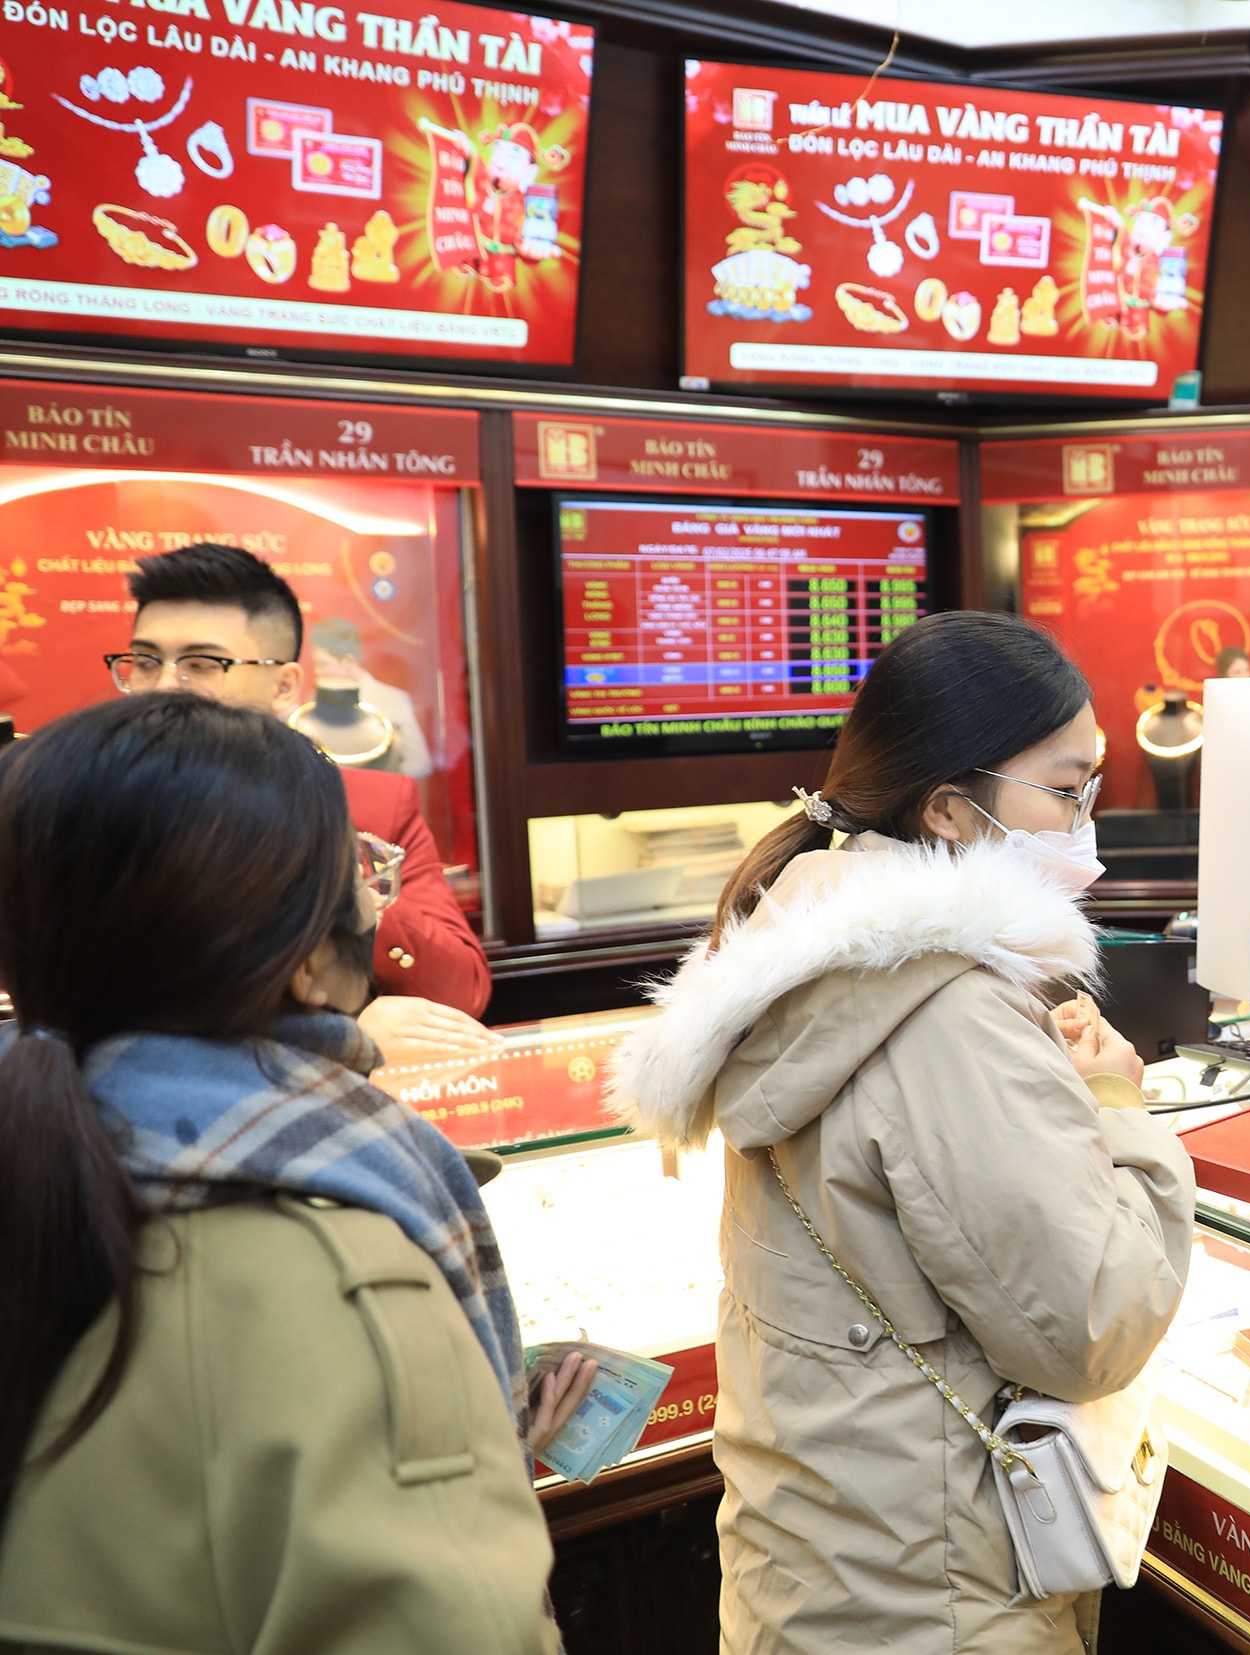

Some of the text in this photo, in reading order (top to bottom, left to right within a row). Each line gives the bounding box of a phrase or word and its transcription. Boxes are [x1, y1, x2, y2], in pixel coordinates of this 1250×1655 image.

[356, 14, 470, 64] THẦN
[478, 32, 542, 75] TÀI
[147, 24, 202, 53] LÂU
[210, 34, 257, 62] DÀI
[279, 47, 317, 72] AN
[323, 54, 410, 87] KHANG
[417, 69, 465, 95] PHÚ
[470, 77, 540, 106] THỊNH
[855, 99, 931, 134] MUA
[936, 103, 1029, 143] VÀNG
[1035, 112, 1124, 154] THẦN
[1129, 121, 1180, 157] TÀI
[883, 139, 923, 161] LÂU
[927, 143, 962, 164] DÀI
[976, 149, 1006, 168] AN
[1008, 152, 1075, 174] KHANG
[1078, 157, 1118, 178] PHÚ
[1121, 161, 1176, 183] THỊNH
[27, 403, 132, 429] BẢO TÍN
[4, 428, 155, 457] MINH CHÂU
[337, 420, 373, 444] 29
[250, 440, 456, 475] TRẦN NHÂN TÔNG
[687, 437, 716, 459] TÍN
[857, 448, 884, 469] 29
[630, 459, 732, 482] MINH CHÂU
[845, 469, 894, 492] NHÂN
[897, 472, 943, 495] TÔNG
[86, 527, 154, 550] VÀNG
[158, 531, 236, 551] TRNG
[446, 1074, 498, 1098] MÔN
[1163, 1519, 1206, 1565] BẰNG
